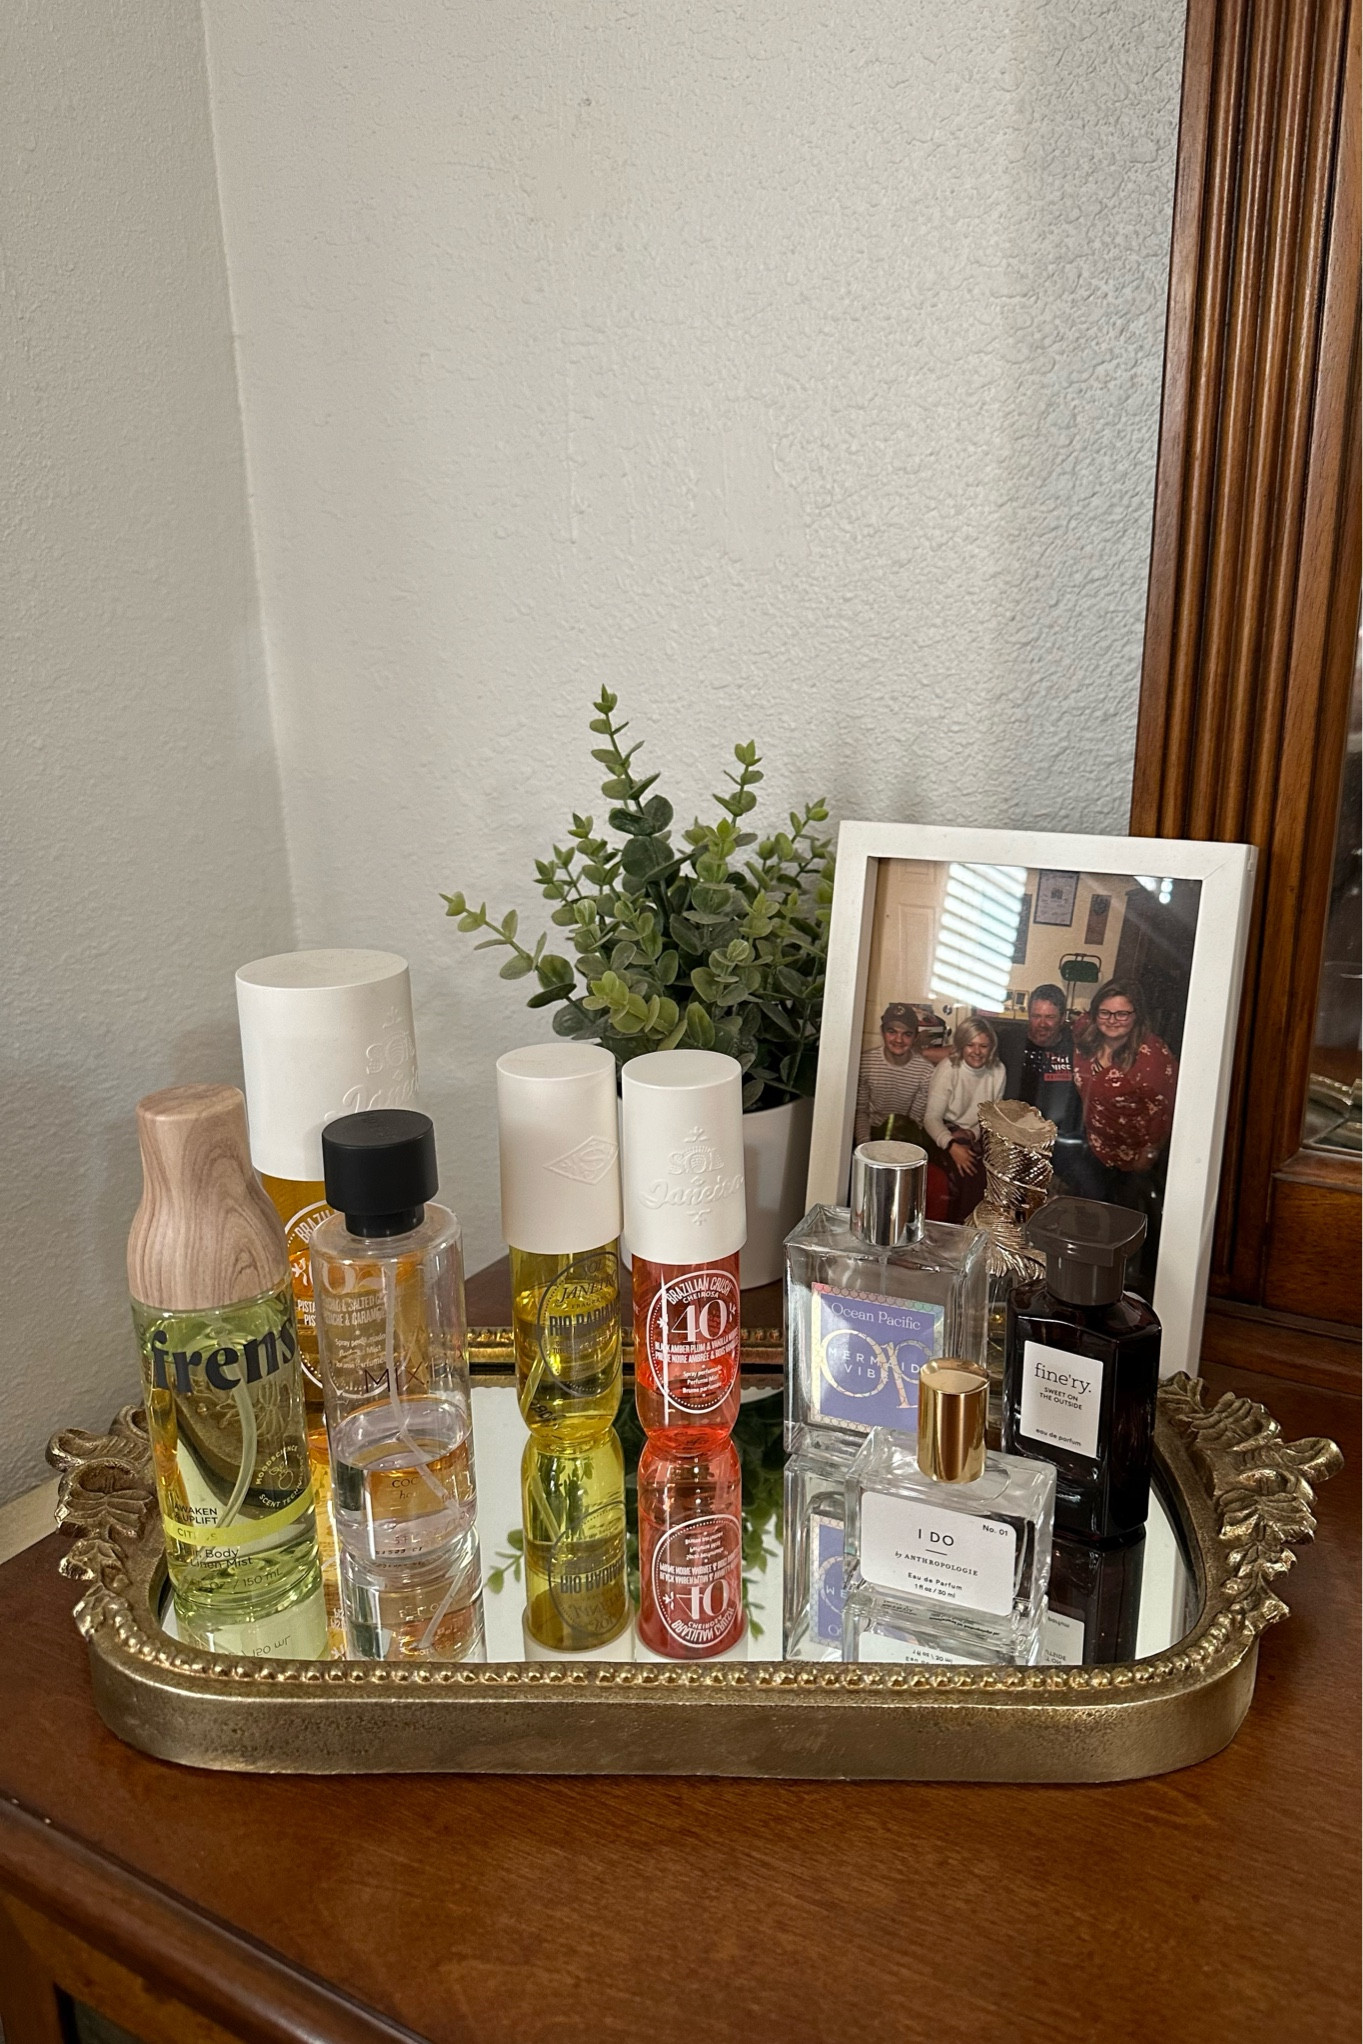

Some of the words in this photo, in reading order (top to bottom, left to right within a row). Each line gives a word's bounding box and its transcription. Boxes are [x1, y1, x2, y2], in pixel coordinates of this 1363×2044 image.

[666, 1277, 709, 1305] BRAZILIAN
[710, 1276, 732, 1296] CRUSH
[683, 1291, 719, 1303] CHEIROSA
[549, 1314, 572, 1335] RIO
[671, 1299, 727, 1342] 40
[831, 1302, 874, 1321] Ocean
[878, 1311, 921, 1330] Pacific
[151, 1318, 297, 1394] frens
[671, 1344, 690, 1353] AMBER
[690, 1343, 705, 1352] PLUM
[828, 1348, 920, 1373] MERMAID
[1034, 1362, 1091, 1394] fine'ry.
[1040, 1392, 1052, 1401] THE
[1053, 1397, 1082, 1410] OUTSIDE
[1044, 1387, 1066, 1398] SWEET
[1067, 1394, 1078, 1402] ON
[1036, 1428, 1048, 1436] eau
[1058, 1435, 1082, 1446] parfum
[174, 1503, 218, 1515] AWAKEN
[259, 1493, 281, 1507] SCENT
[182, 1513, 218, 1525] UPLIFT
[177, 1527, 218, 1541] CITS
[918, 1528, 922, 1539] I
[930, 1531, 954, 1546] DO
[982, 1524, 997, 1533] No.
[205, 1548, 239, 1559] Body
[190, 1558, 222, 1570] Linen
[226, 1557, 253, 1568] Mist
[895, 1551, 902, 1559] by
[904, 1553, 979, 1576] ANTHROPOLOGIE
[243, 1577, 263, 1586] 150
[265, 1568, 282, 1579] mL
[908, 1572, 921, 1581] Eau
[935, 1579, 963, 1590] Parfum
